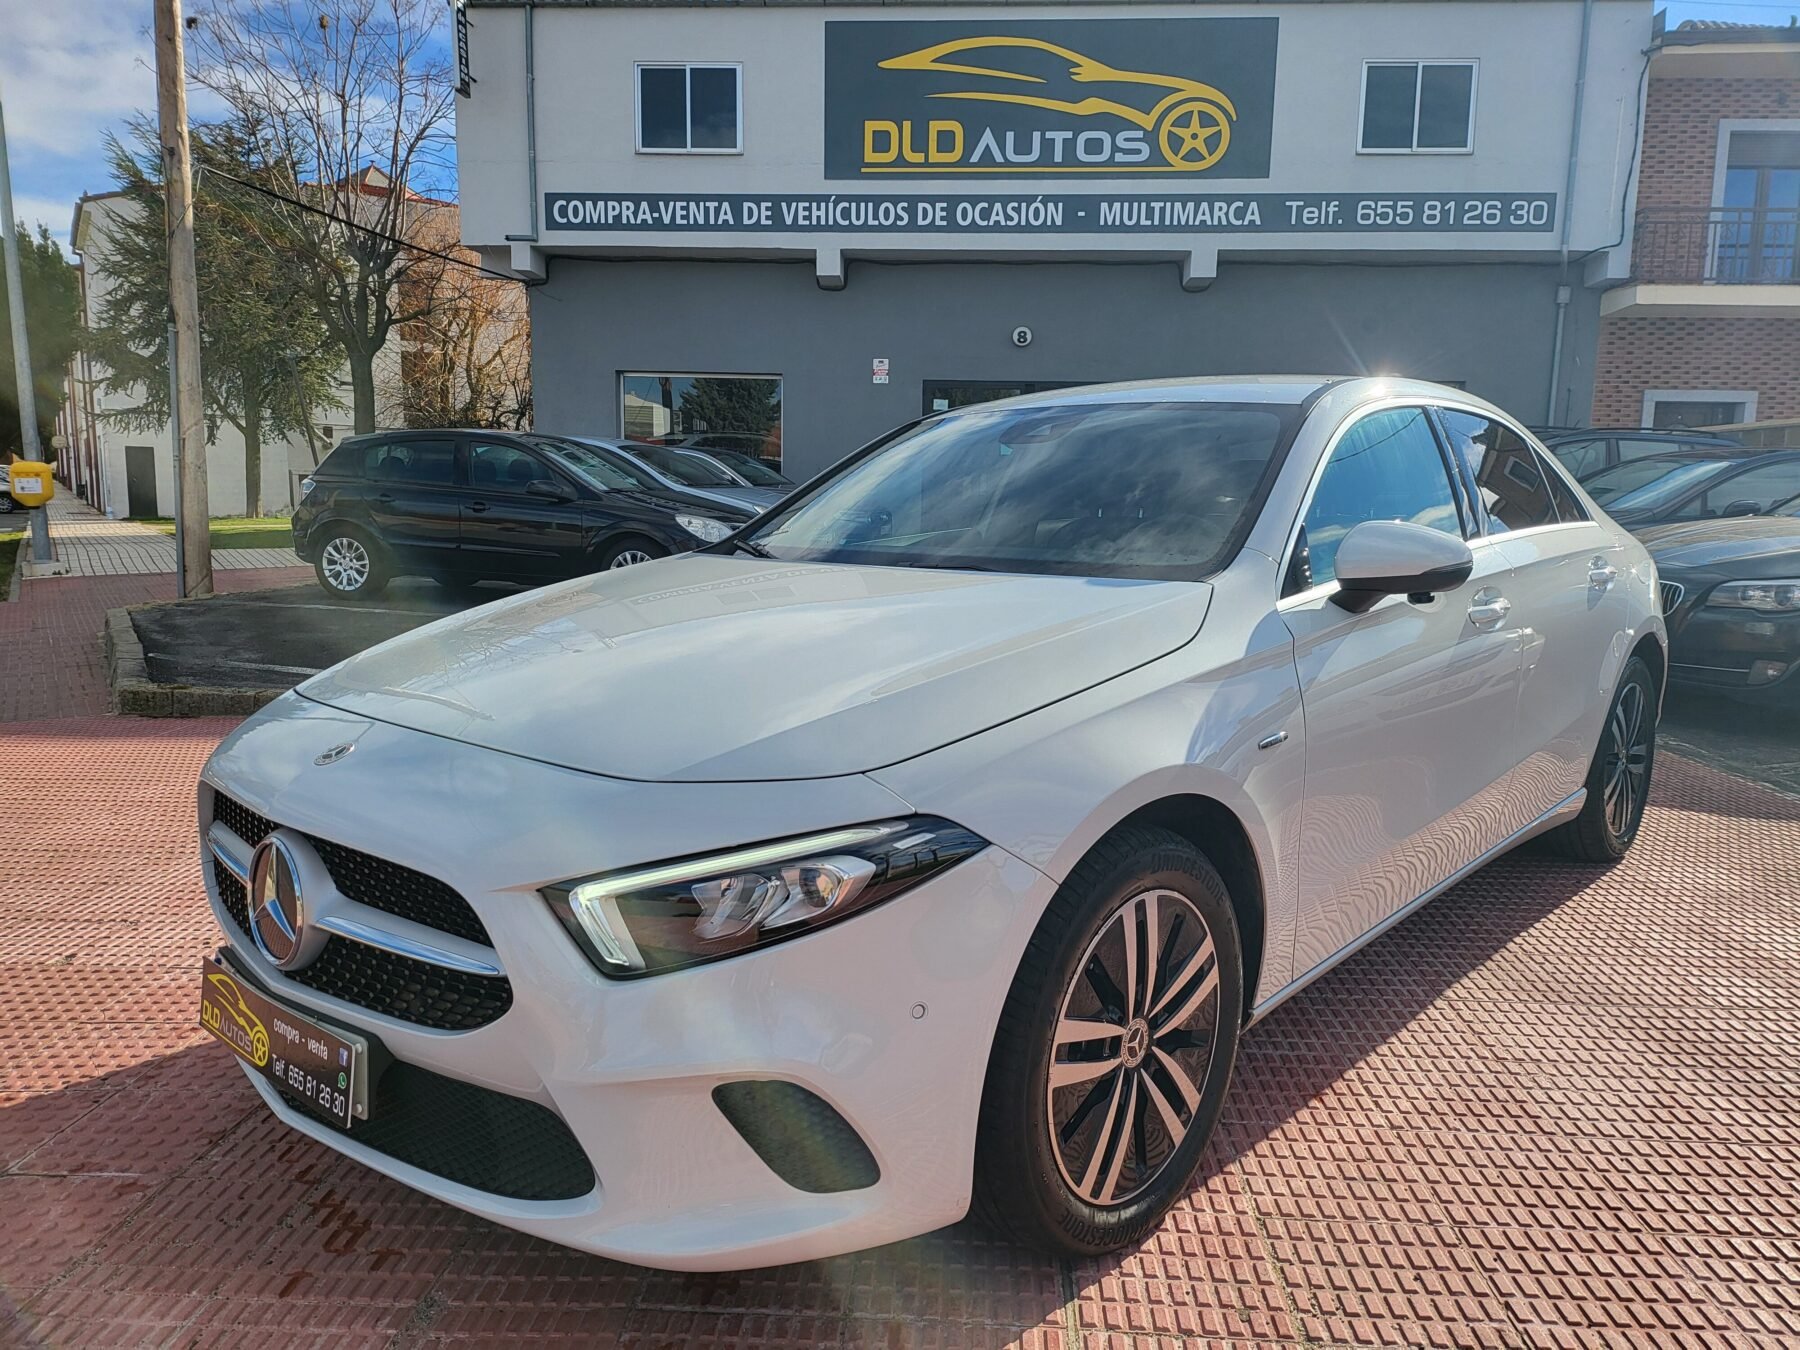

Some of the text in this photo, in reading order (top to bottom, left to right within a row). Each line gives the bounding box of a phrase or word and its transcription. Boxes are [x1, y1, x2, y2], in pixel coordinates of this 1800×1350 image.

[864, 119, 1151, 163] DLD AUTOS
[552, 199, 734, 226] COMPRA-VENTA
[742, 200, 773, 226] DE
[780, 195, 909, 227] VEHÍCULOS
[917, 201, 947, 226] DE
[956, 195, 1063, 227] OCASIÓN
[1099, 201, 1261, 226] MULTIMARCA
[1285, 200, 1343, 226] Telf.
[1356, 200, 1414, 225] 655
[1422, 200, 1456, 225] 81
[1463, 200, 1501, 225] 26
[1509, 200, 1549, 225] 30
[1017, 330, 1029, 344] 8
[203, 1000, 252, 1053] DLD AUTOS
[273, 1018, 300, 1045] compra
[307, 1036, 329, 1061] venta
[271, 1054, 345, 1117] Telf. 655 81 26 30
